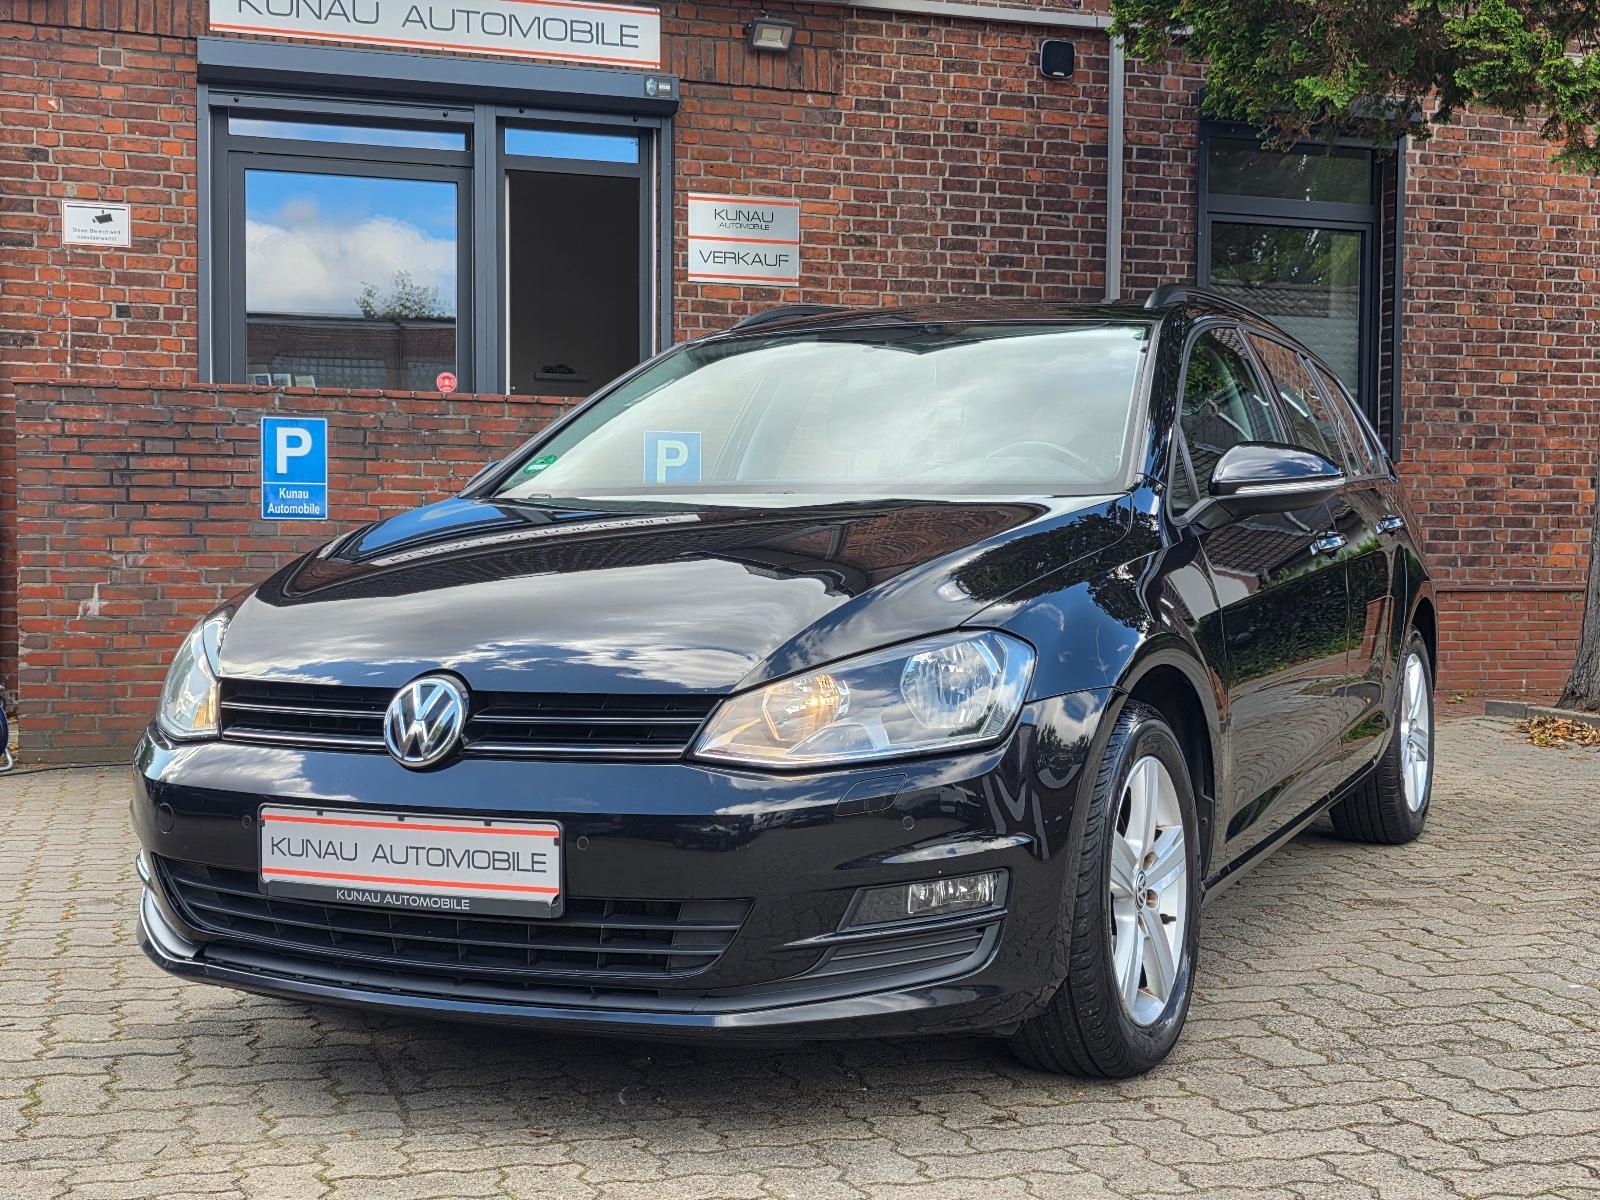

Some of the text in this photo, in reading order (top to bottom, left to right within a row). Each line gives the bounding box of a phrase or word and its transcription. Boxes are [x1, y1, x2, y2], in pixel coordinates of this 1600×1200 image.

[401, 5, 639, 48] AUTOMOBILE
[714, 208, 774, 223] KUNAU
[719, 222, 770, 231] AUTOMOBILE
[699, 250, 790, 267] VERKAUF
[276, 427, 312, 474] P
[656, 439, 689, 483] P
[279, 487, 309, 499] Kunau
[267, 503, 320, 514] Automobile
[271, 836, 547, 873] KUNAU AUTOMOBILE
[336, 889, 470, 910] KUNAU AUTOMOBILE
